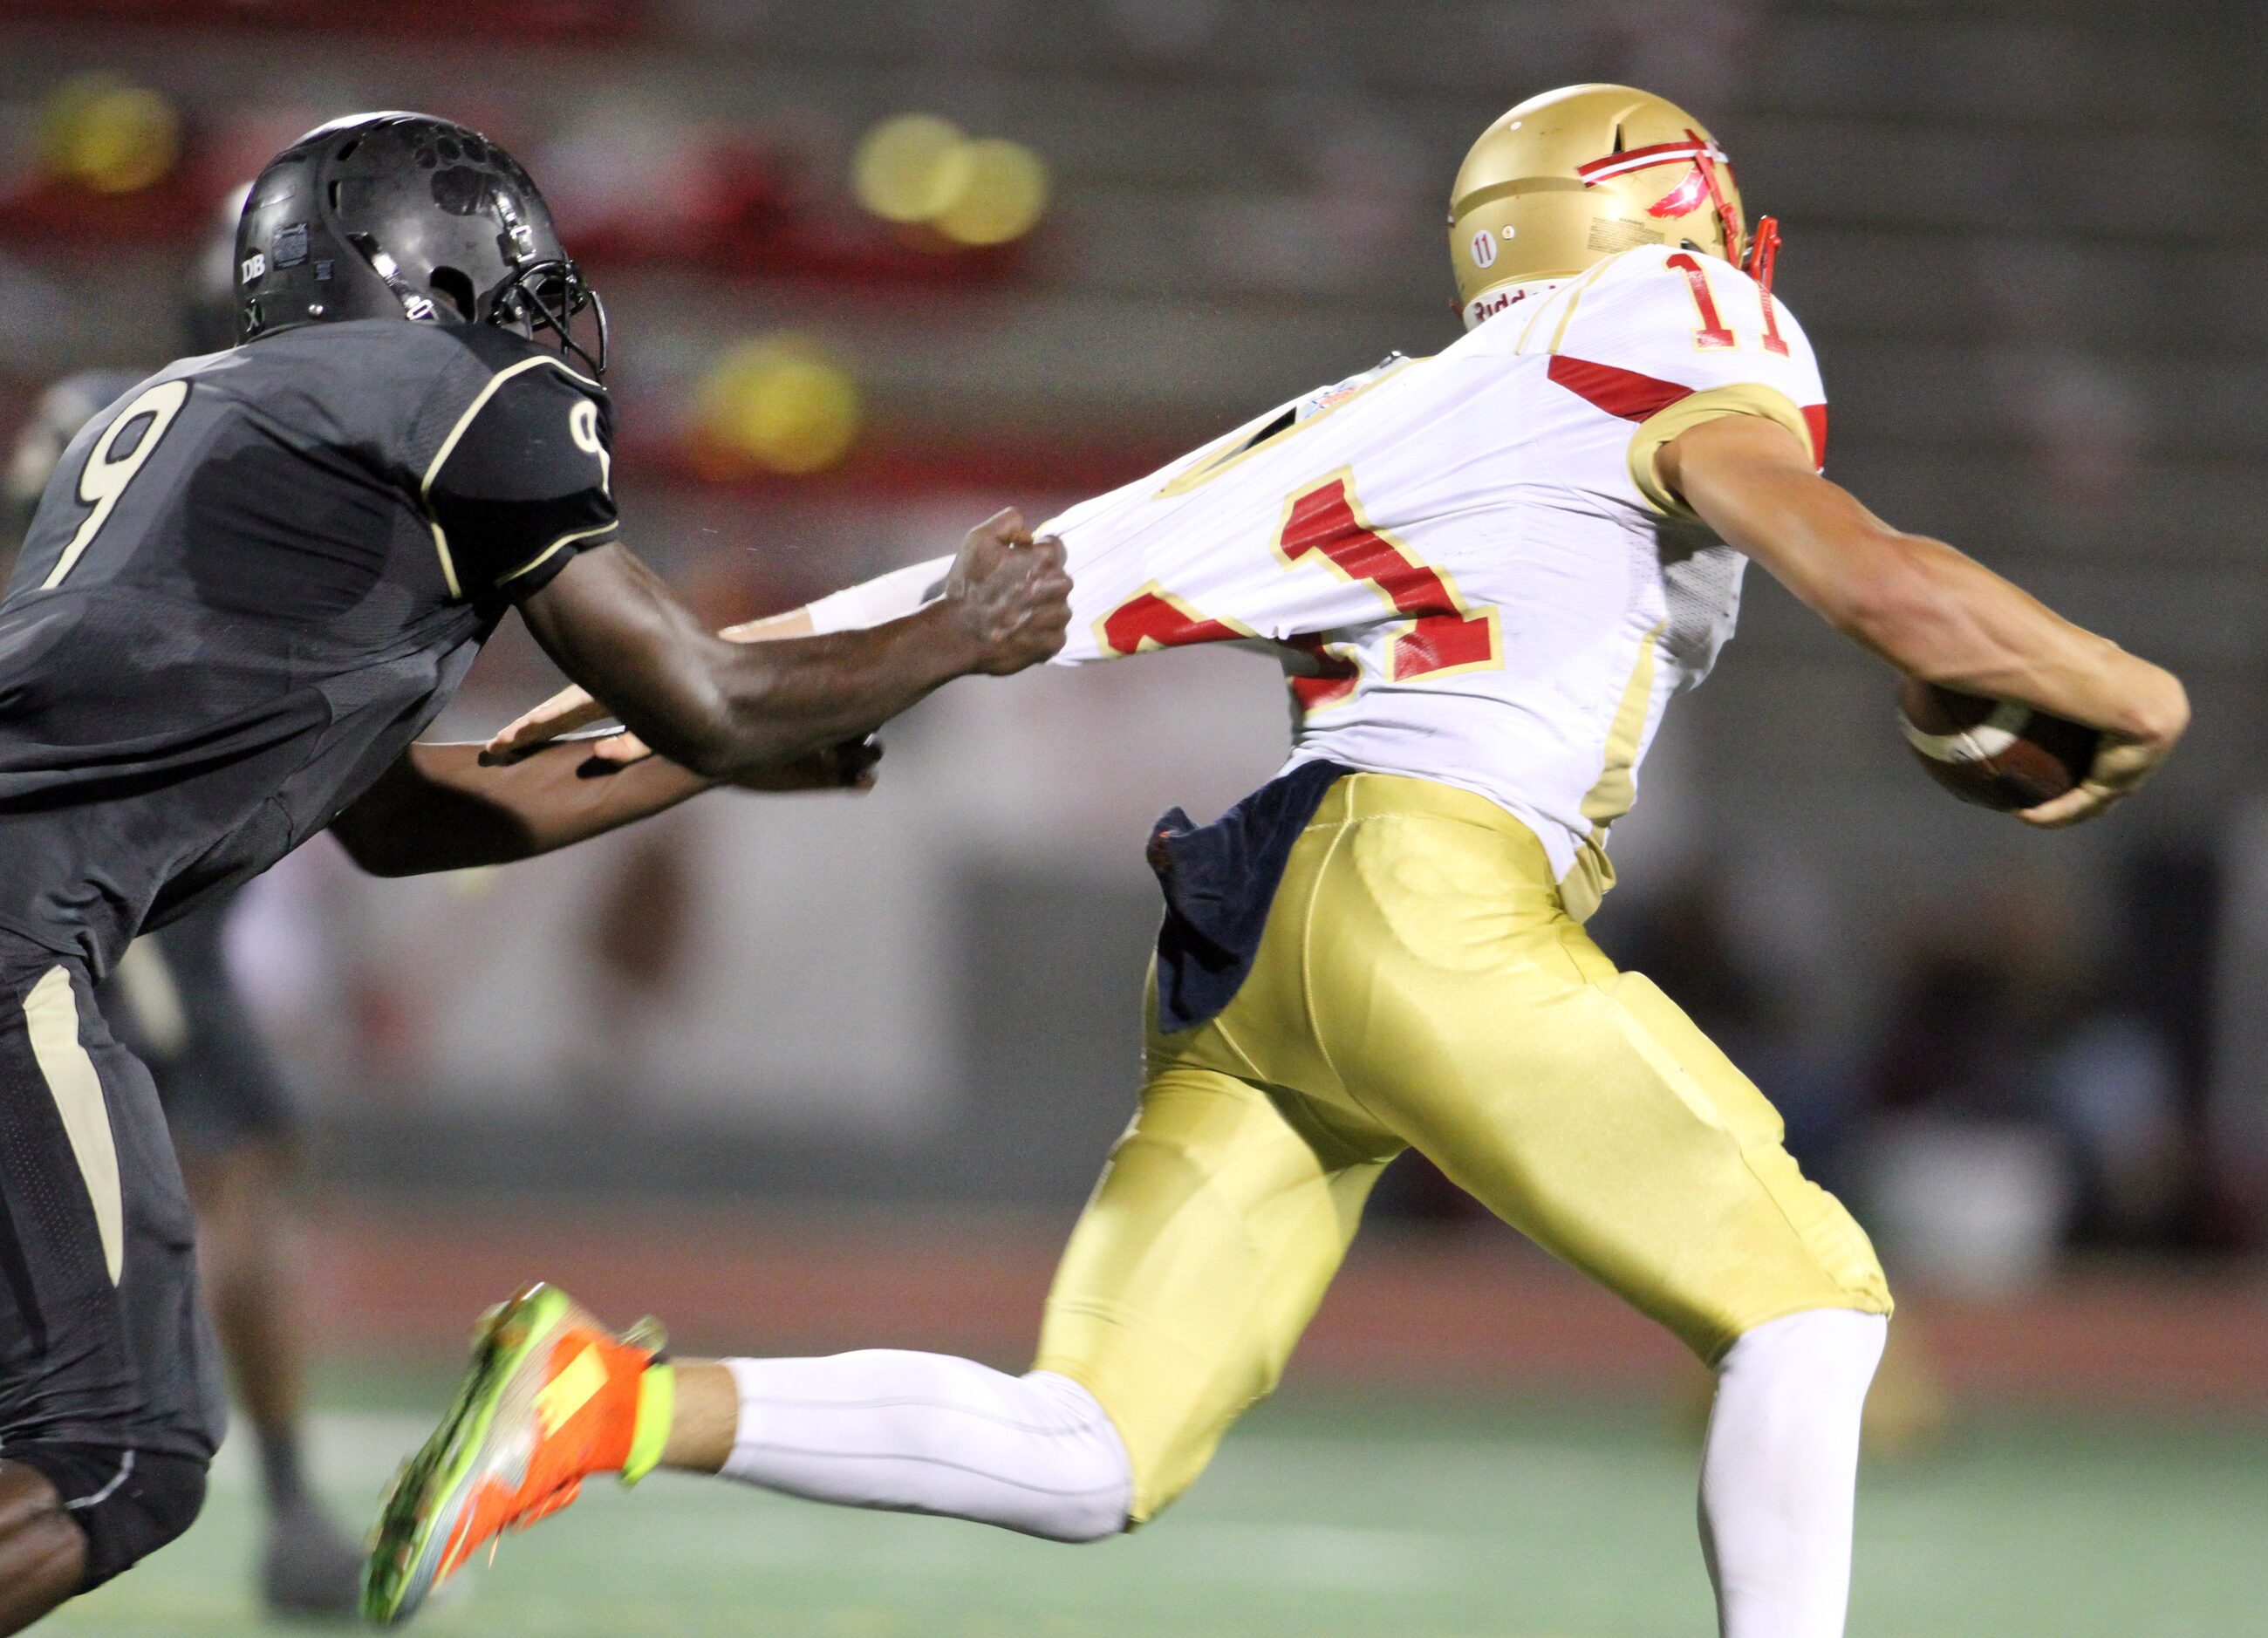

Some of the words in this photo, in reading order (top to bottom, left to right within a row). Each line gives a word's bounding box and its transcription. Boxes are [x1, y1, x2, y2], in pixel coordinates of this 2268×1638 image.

[242, 254, 265, 285] DB
[1474, 233, 1492, 264] 11
[1664, 252, 1791, 358] 11
[41, 379, 189, 590] 9
[569, 400, 611, 496] 9
